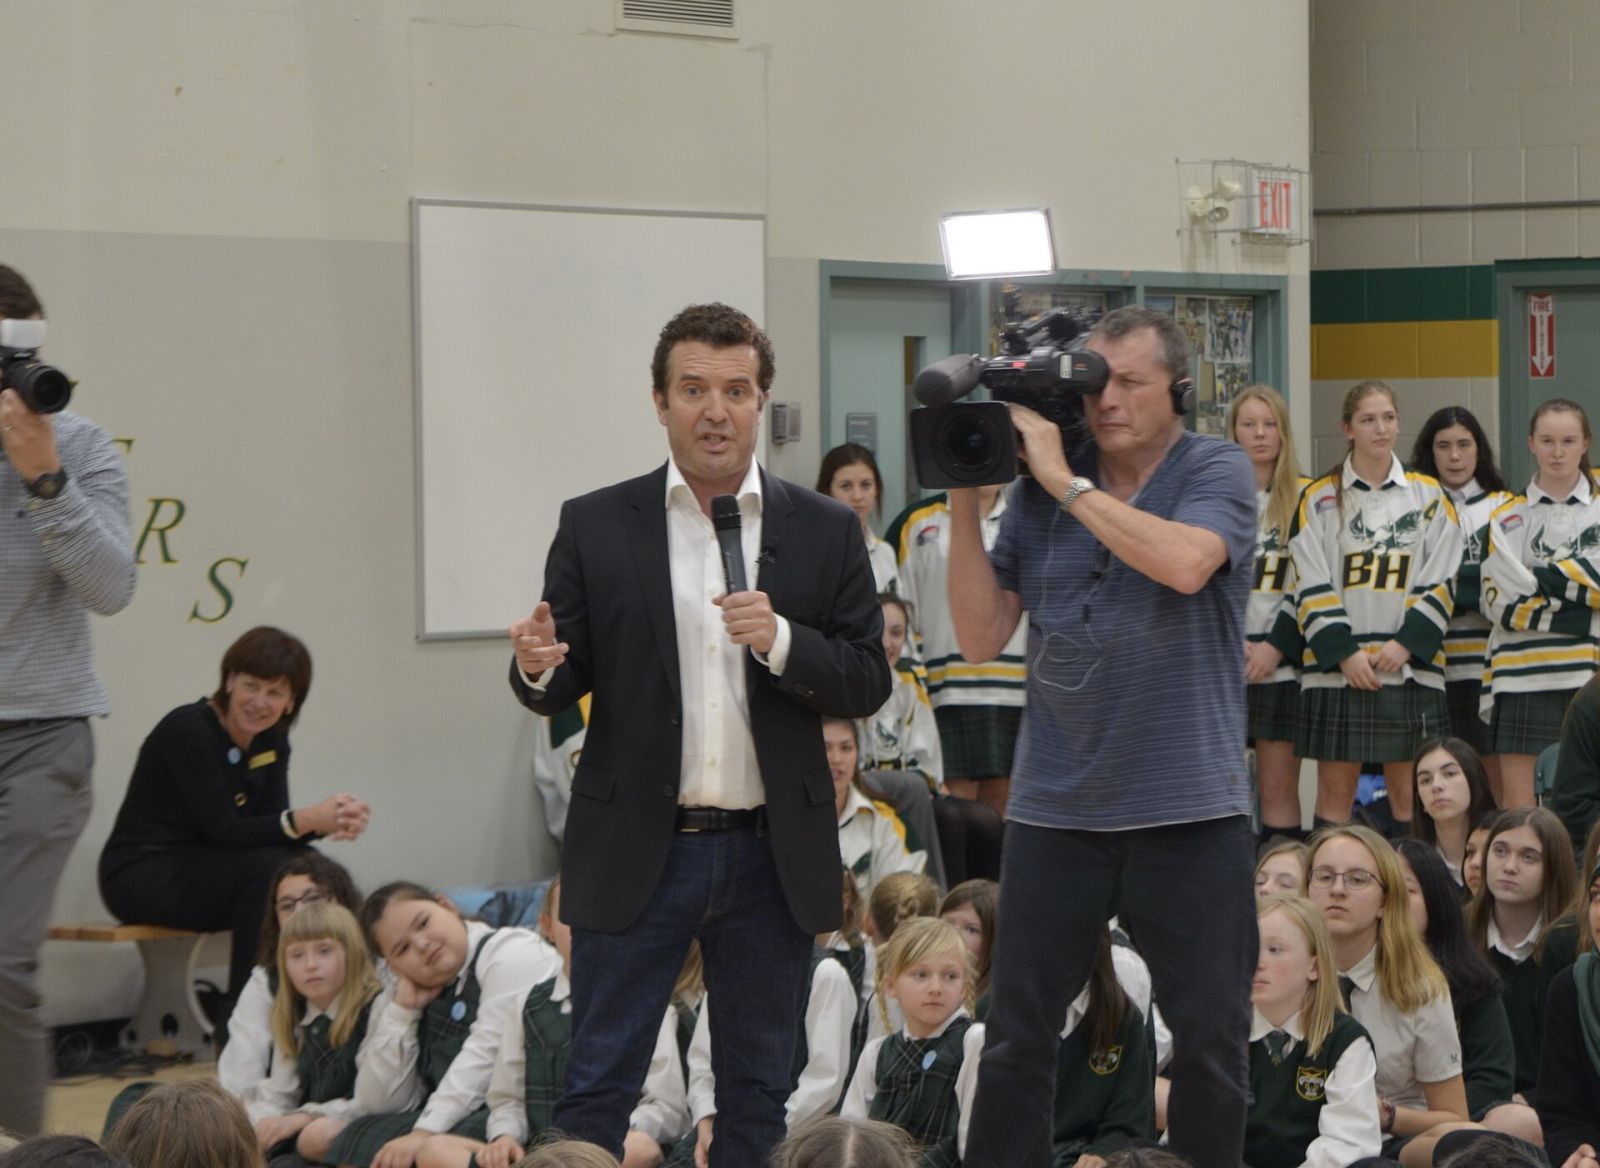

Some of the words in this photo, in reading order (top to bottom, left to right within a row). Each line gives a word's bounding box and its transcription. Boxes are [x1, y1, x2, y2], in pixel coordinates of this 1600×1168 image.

[1259, 180, 1291, 228] EXIT
[1254, 555, 1290, 591] H
[1343, 551, 1412, 590] BH
